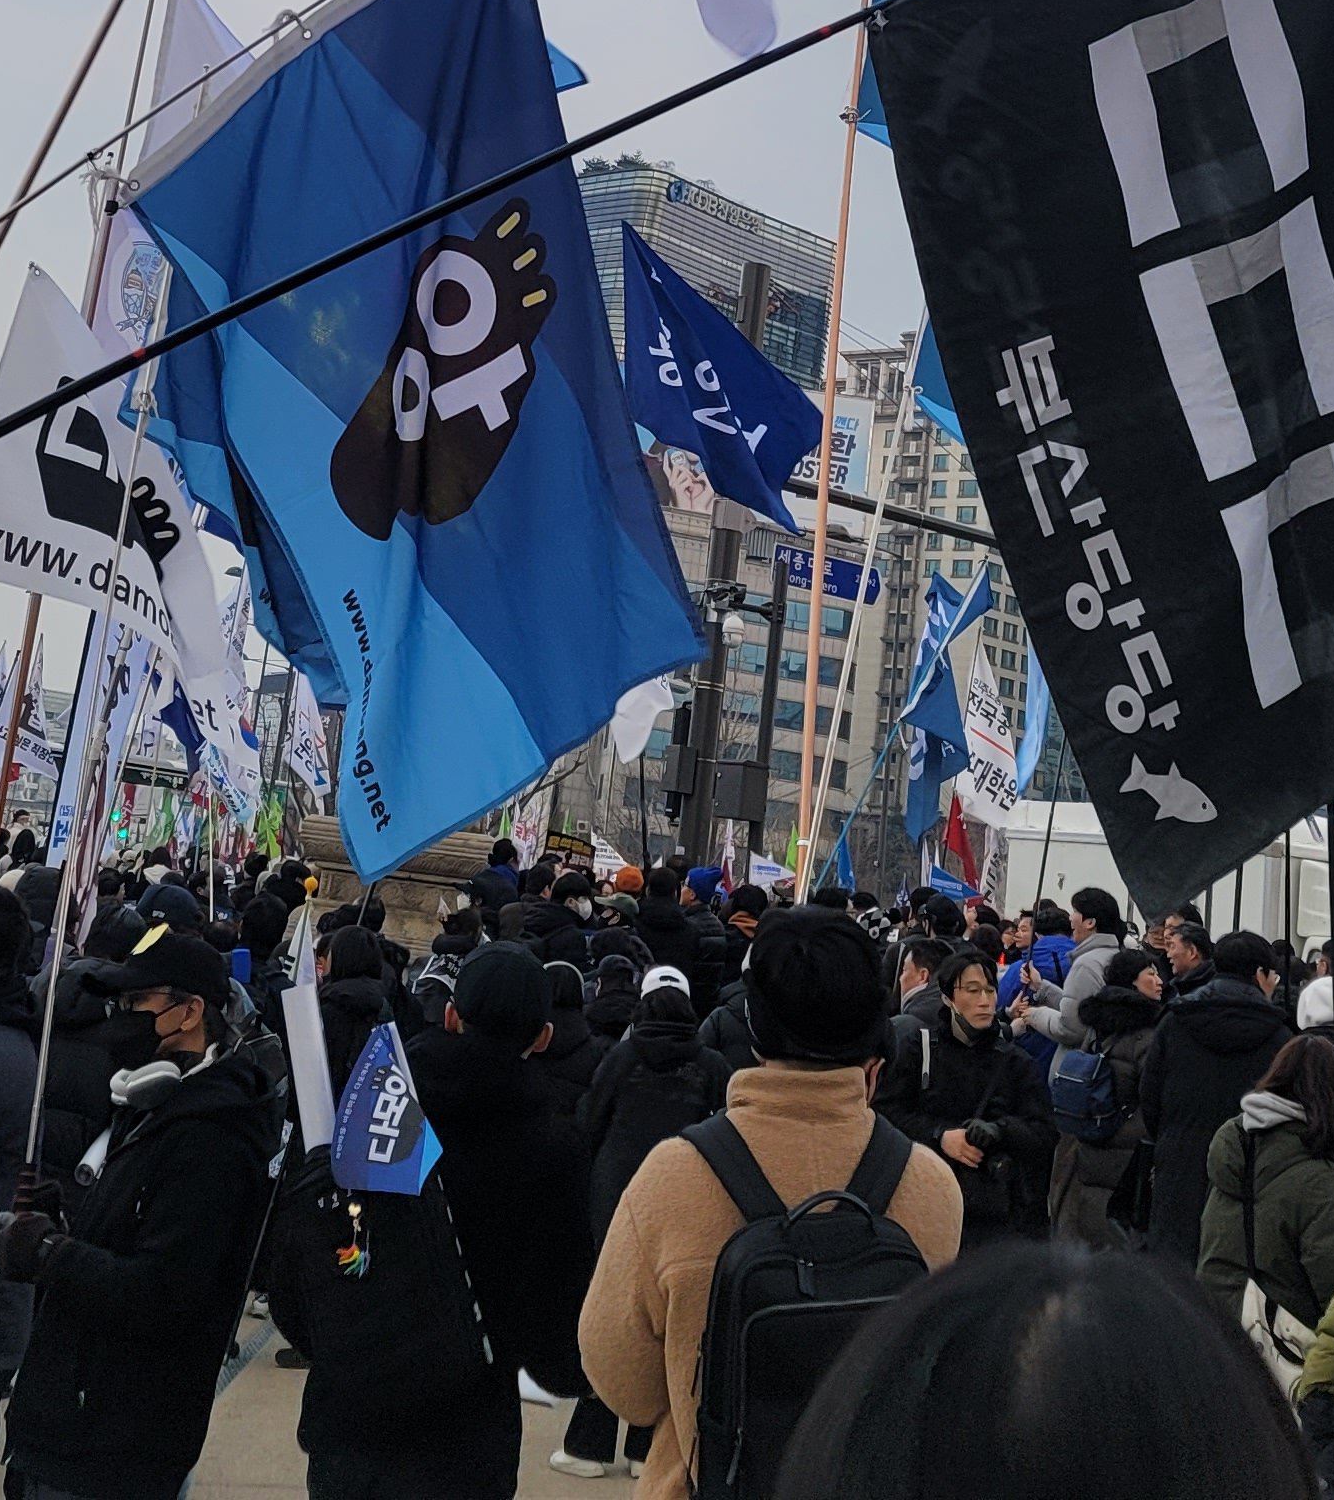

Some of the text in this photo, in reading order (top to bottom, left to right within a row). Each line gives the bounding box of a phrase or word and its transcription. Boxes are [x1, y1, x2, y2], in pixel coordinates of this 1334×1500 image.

[393, 247, 534, 441] 앙
[789, 574, 838, 594] ong-ero
[996, 333, 1181, 735] 부산당당
